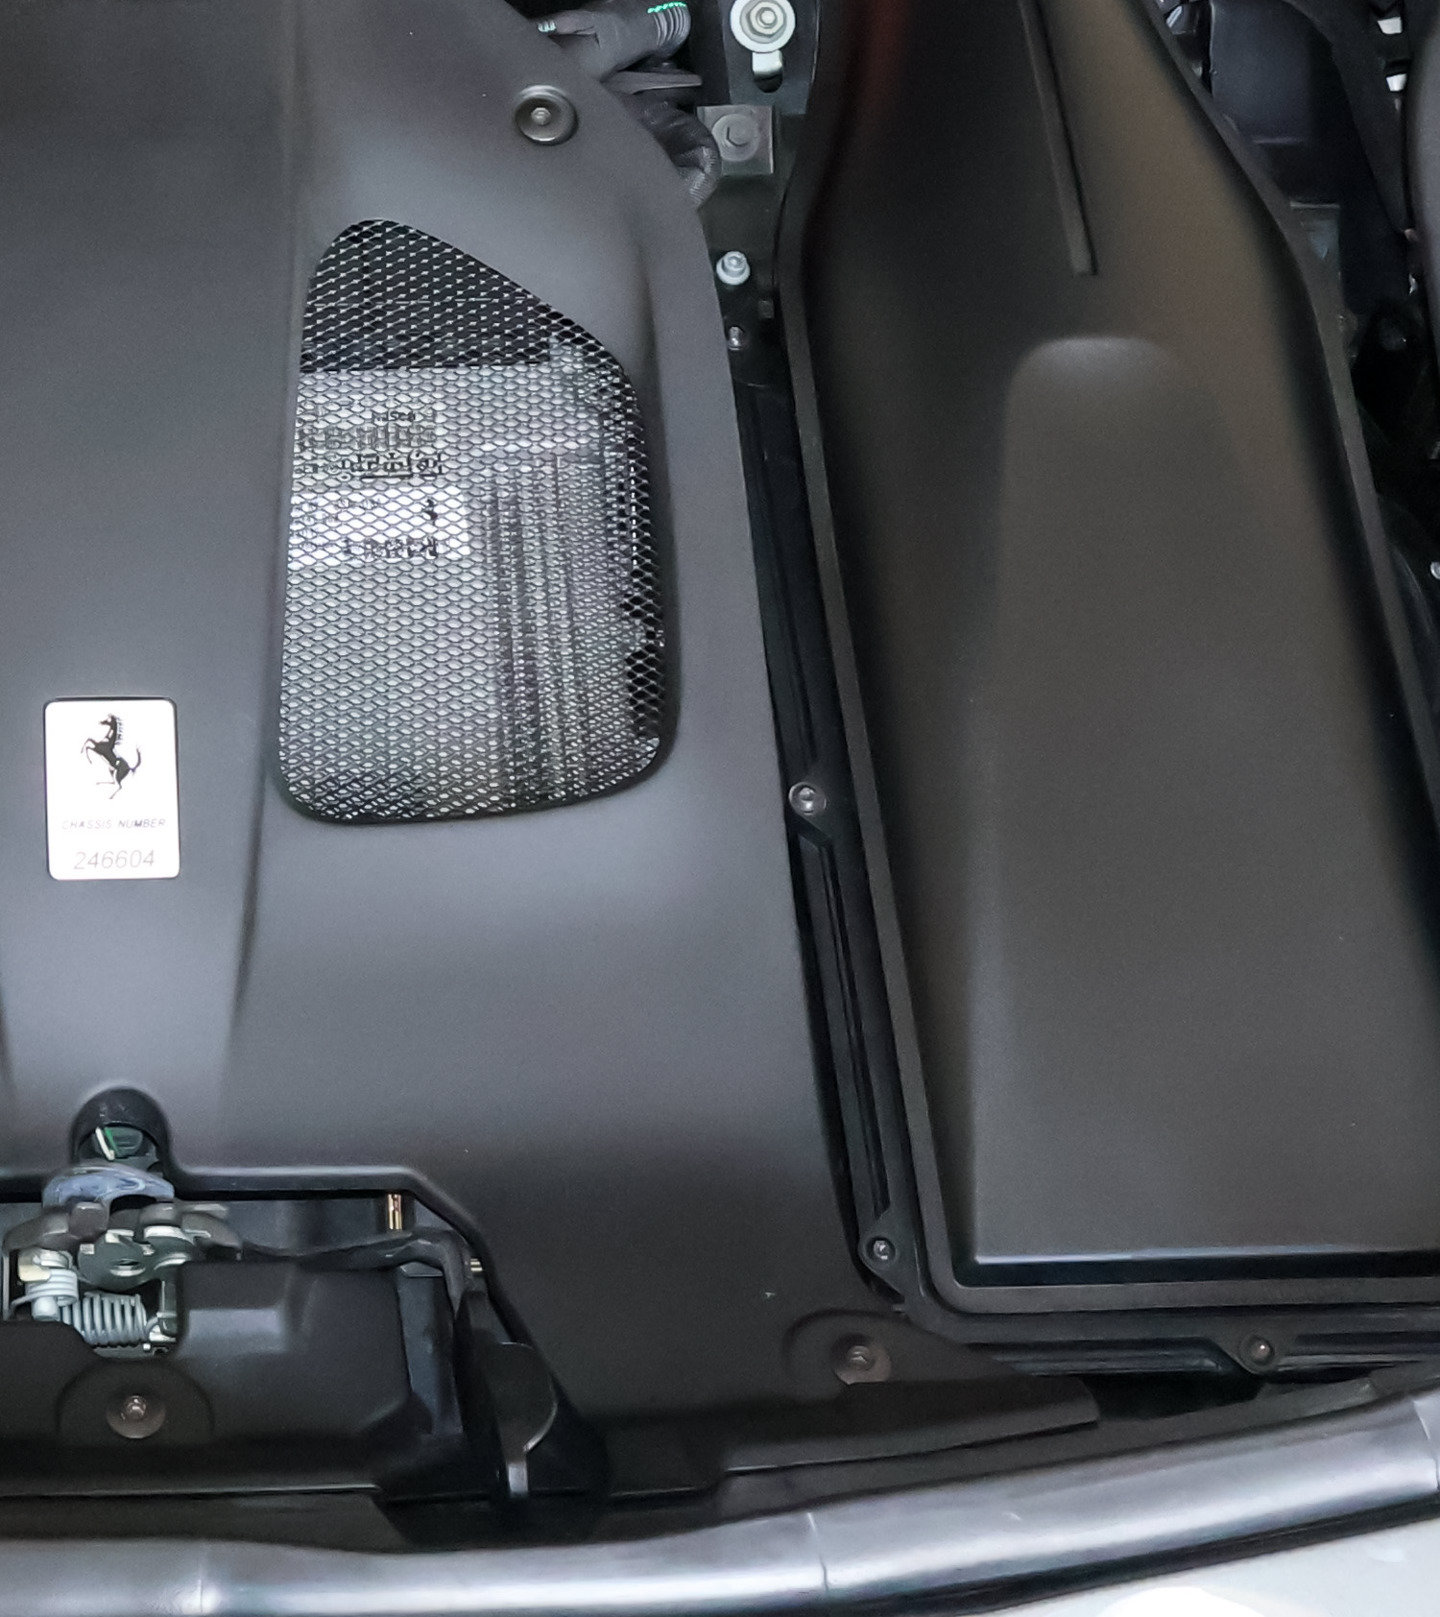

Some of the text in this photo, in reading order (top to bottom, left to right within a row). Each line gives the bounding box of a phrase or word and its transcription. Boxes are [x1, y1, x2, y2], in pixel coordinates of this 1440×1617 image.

[62, 818, 166, 830] CHASSIS NUMBER
[73, 849, 155, 870] 246604
